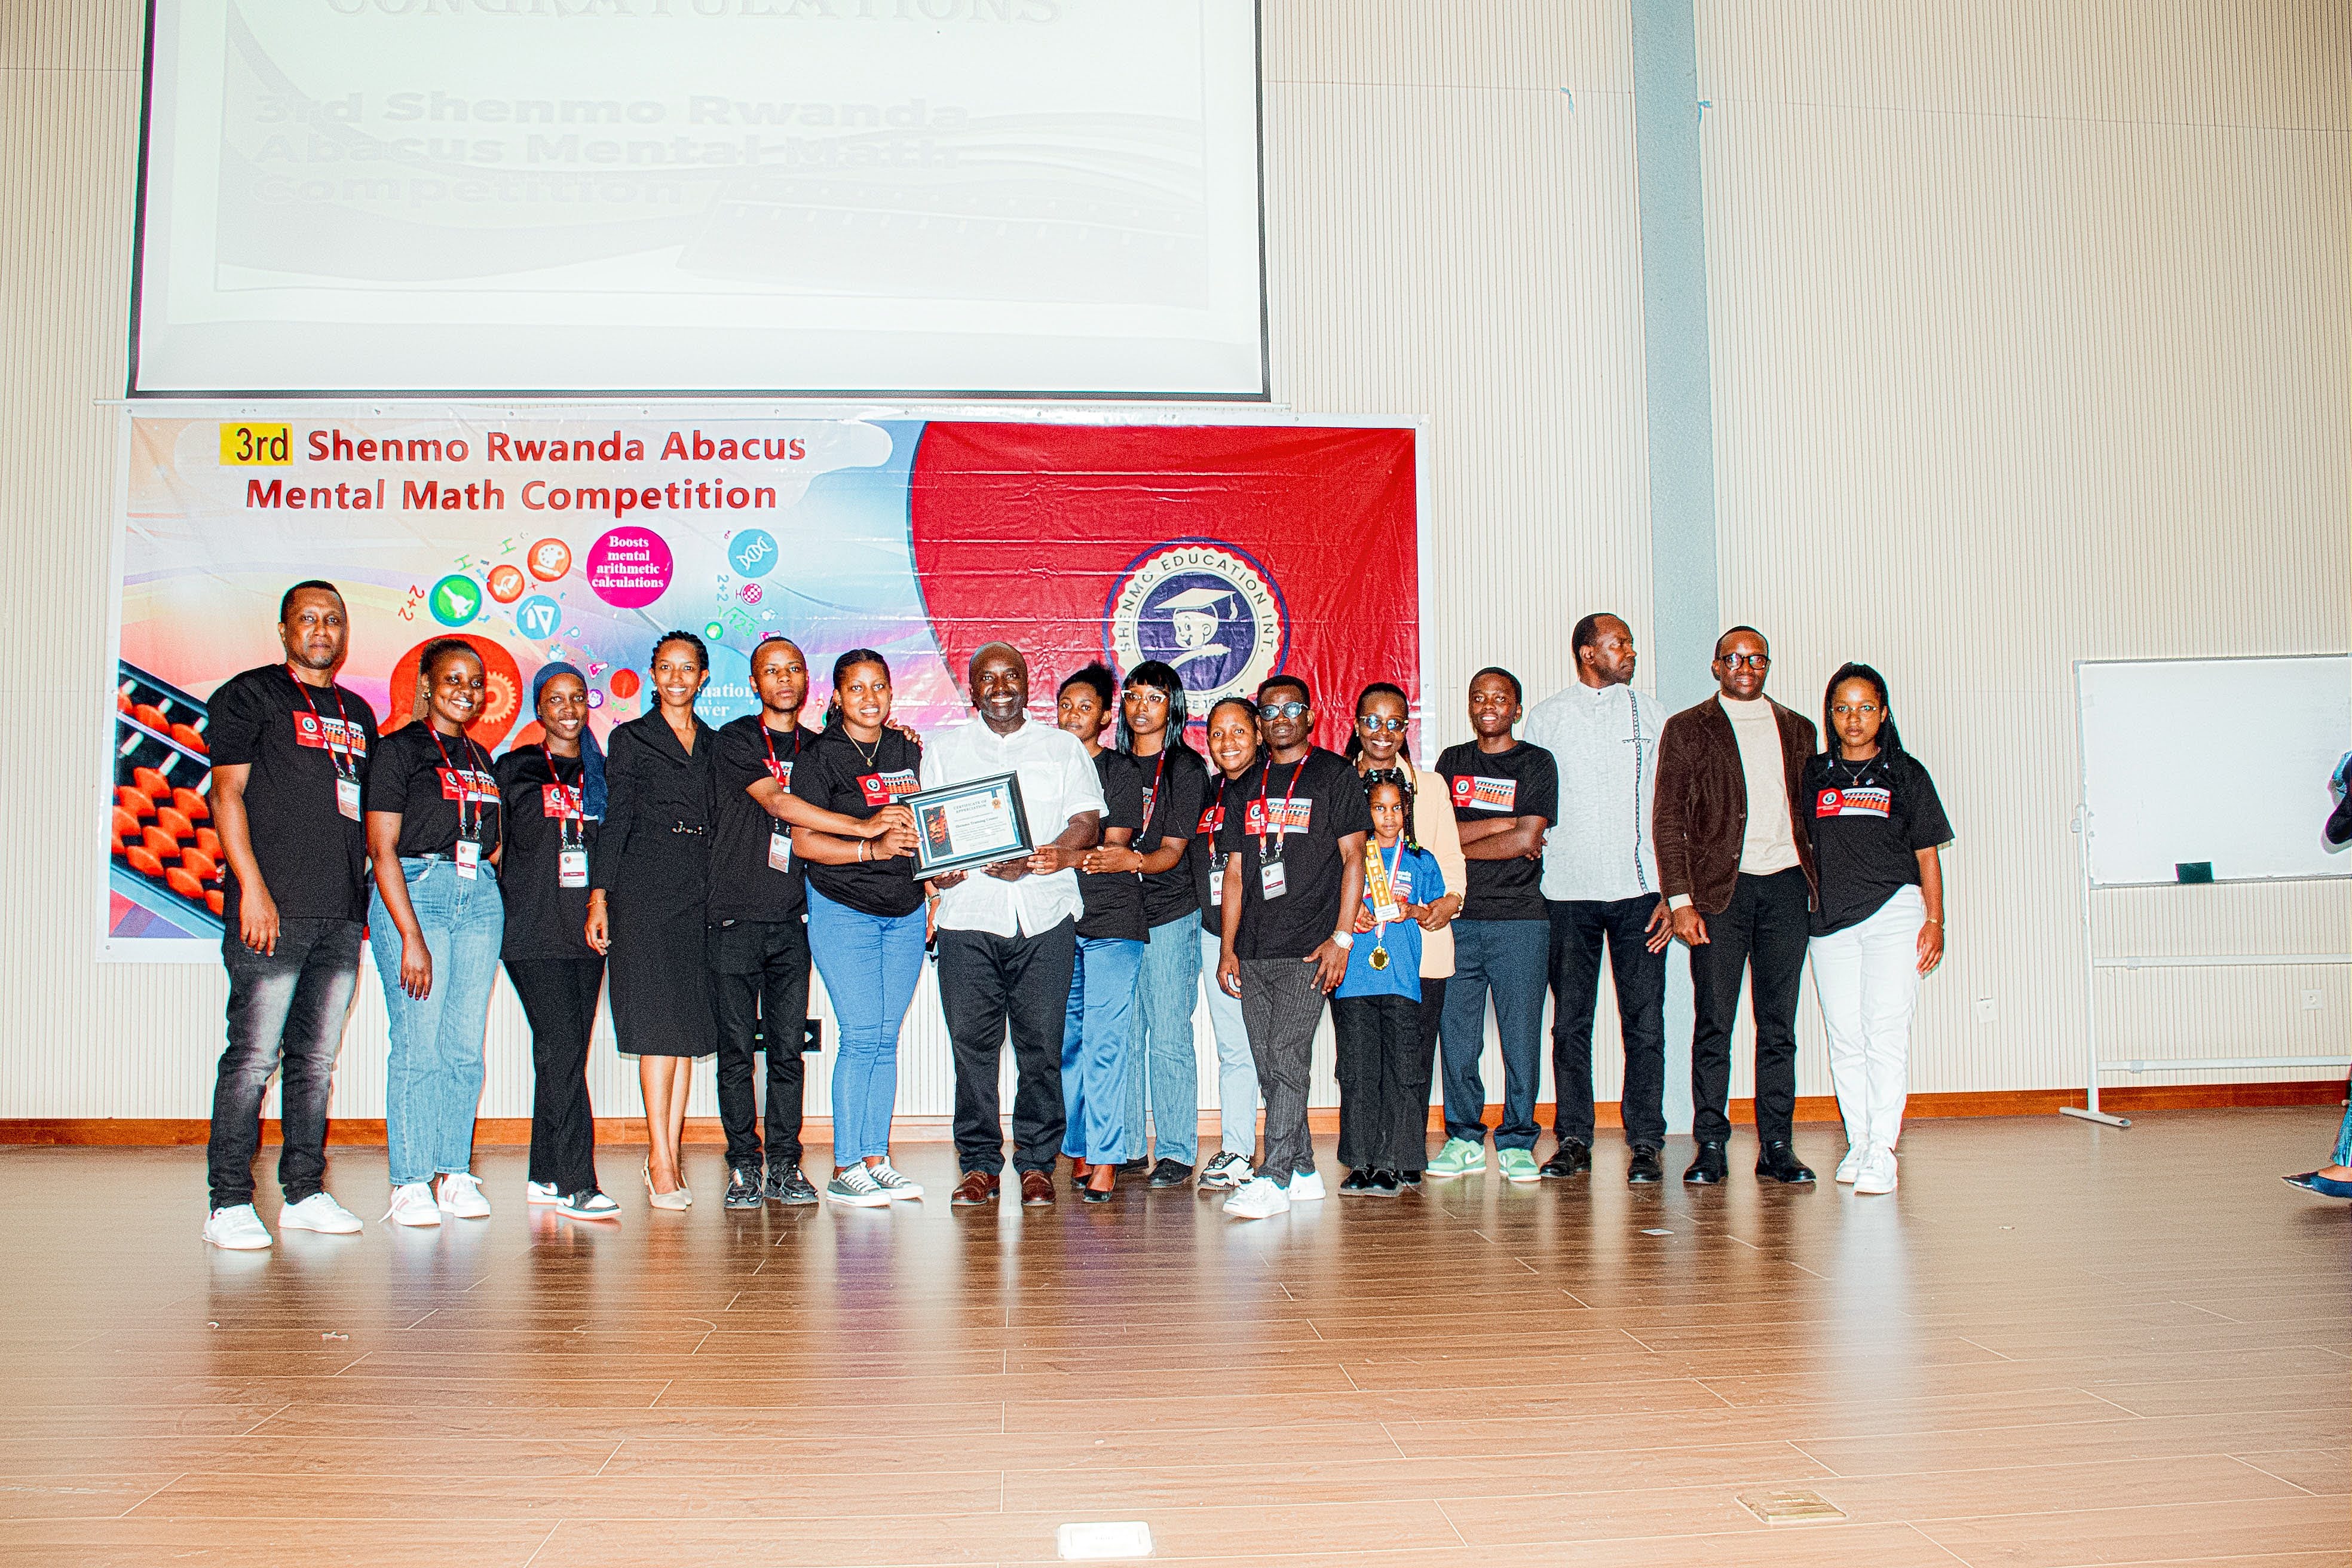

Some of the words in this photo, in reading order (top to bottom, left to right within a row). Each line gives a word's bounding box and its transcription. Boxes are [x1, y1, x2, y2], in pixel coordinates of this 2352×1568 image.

[254, 91, 363, 123] 3rd
[382, 90, 667, 124] Shenmo
[689, 95, 969, 130] Rwanda
[254, 134, 507, 163] Abacus
[526, 133, 761, 166] Mental
[785, 136, 960, 169] Math
[253, 174, 682, 209] Competition
[236, 428, 288, 461] 3rd
[308, 429, 469, 462] Shenmo
[487, 430, 644, 462] Rwanda
[660, 430, 806, 461] Abacus
[246, 479, 384, 509] Mental
[403, 479, 505, 510] Math
[521, 478, 776, 519] Competition
[607, 550, 650, 561] mental
[609, 535, 649, 547] Boosts
[592, 576, 664, 588] calculations
[596, 563, 660, 574] arithmetic
[1161, 553, 1267, 605] EDUCATION
[1118, 571, 1154, 652] SHENMO
[1261, 613, 1274, 653] INT.
[702, 683, 753, 697] nation
[697, 706, 730, 716] wer
